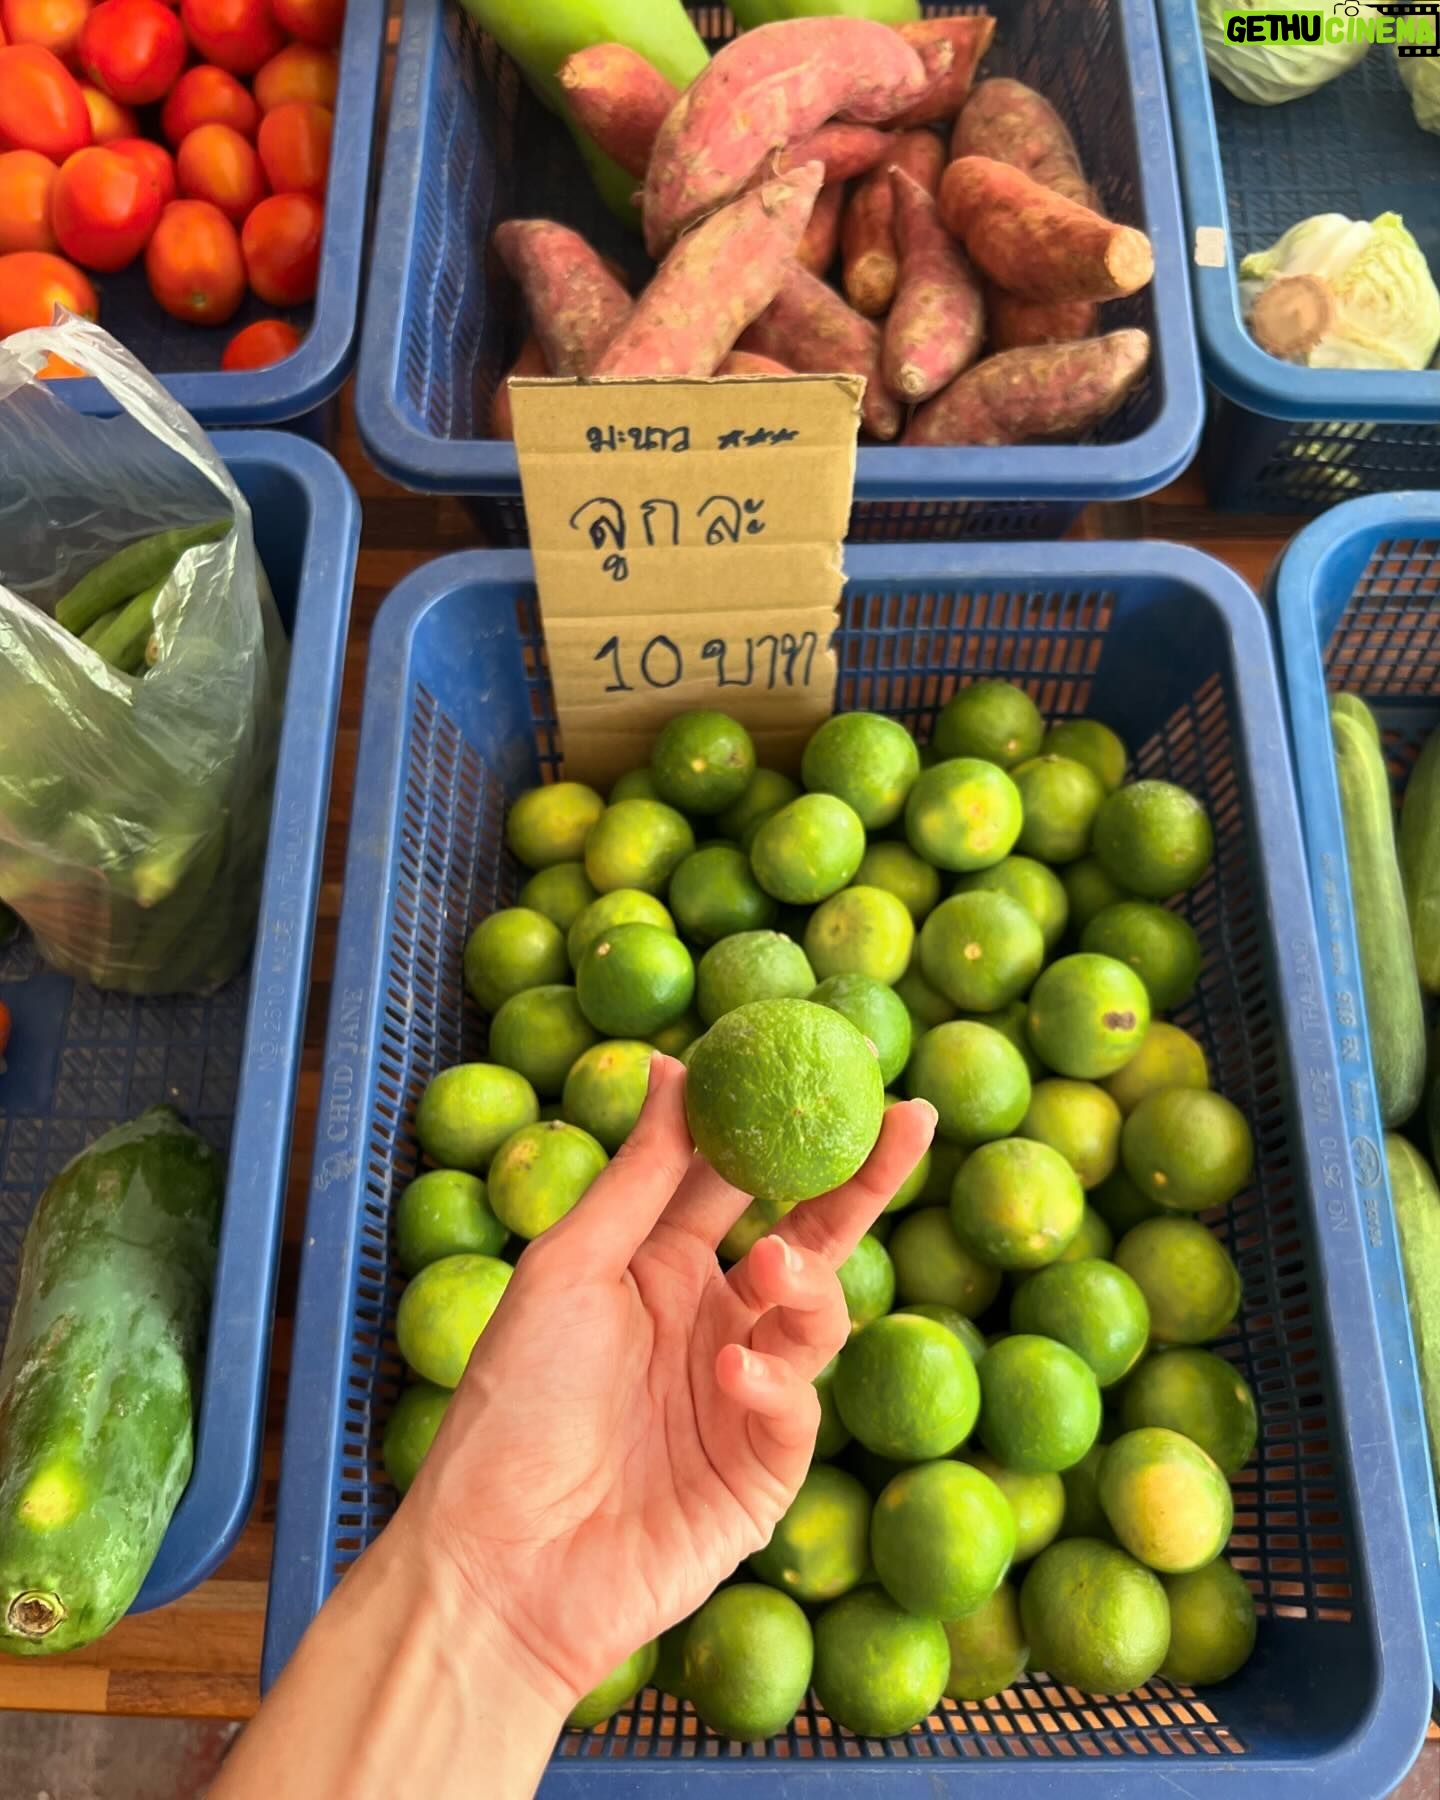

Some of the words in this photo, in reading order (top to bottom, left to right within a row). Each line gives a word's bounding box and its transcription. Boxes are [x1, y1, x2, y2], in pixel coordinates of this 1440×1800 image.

[586, 426, 690, 453] มะนาว
[594, 634, 683, 692] 10
[701, 632, 817, 690] บาท
[336, 988, 364, 1055] JANE
[327, 1065, 354, 1142] CHUD
[1319, 1135, 1344, 1188] 2510
